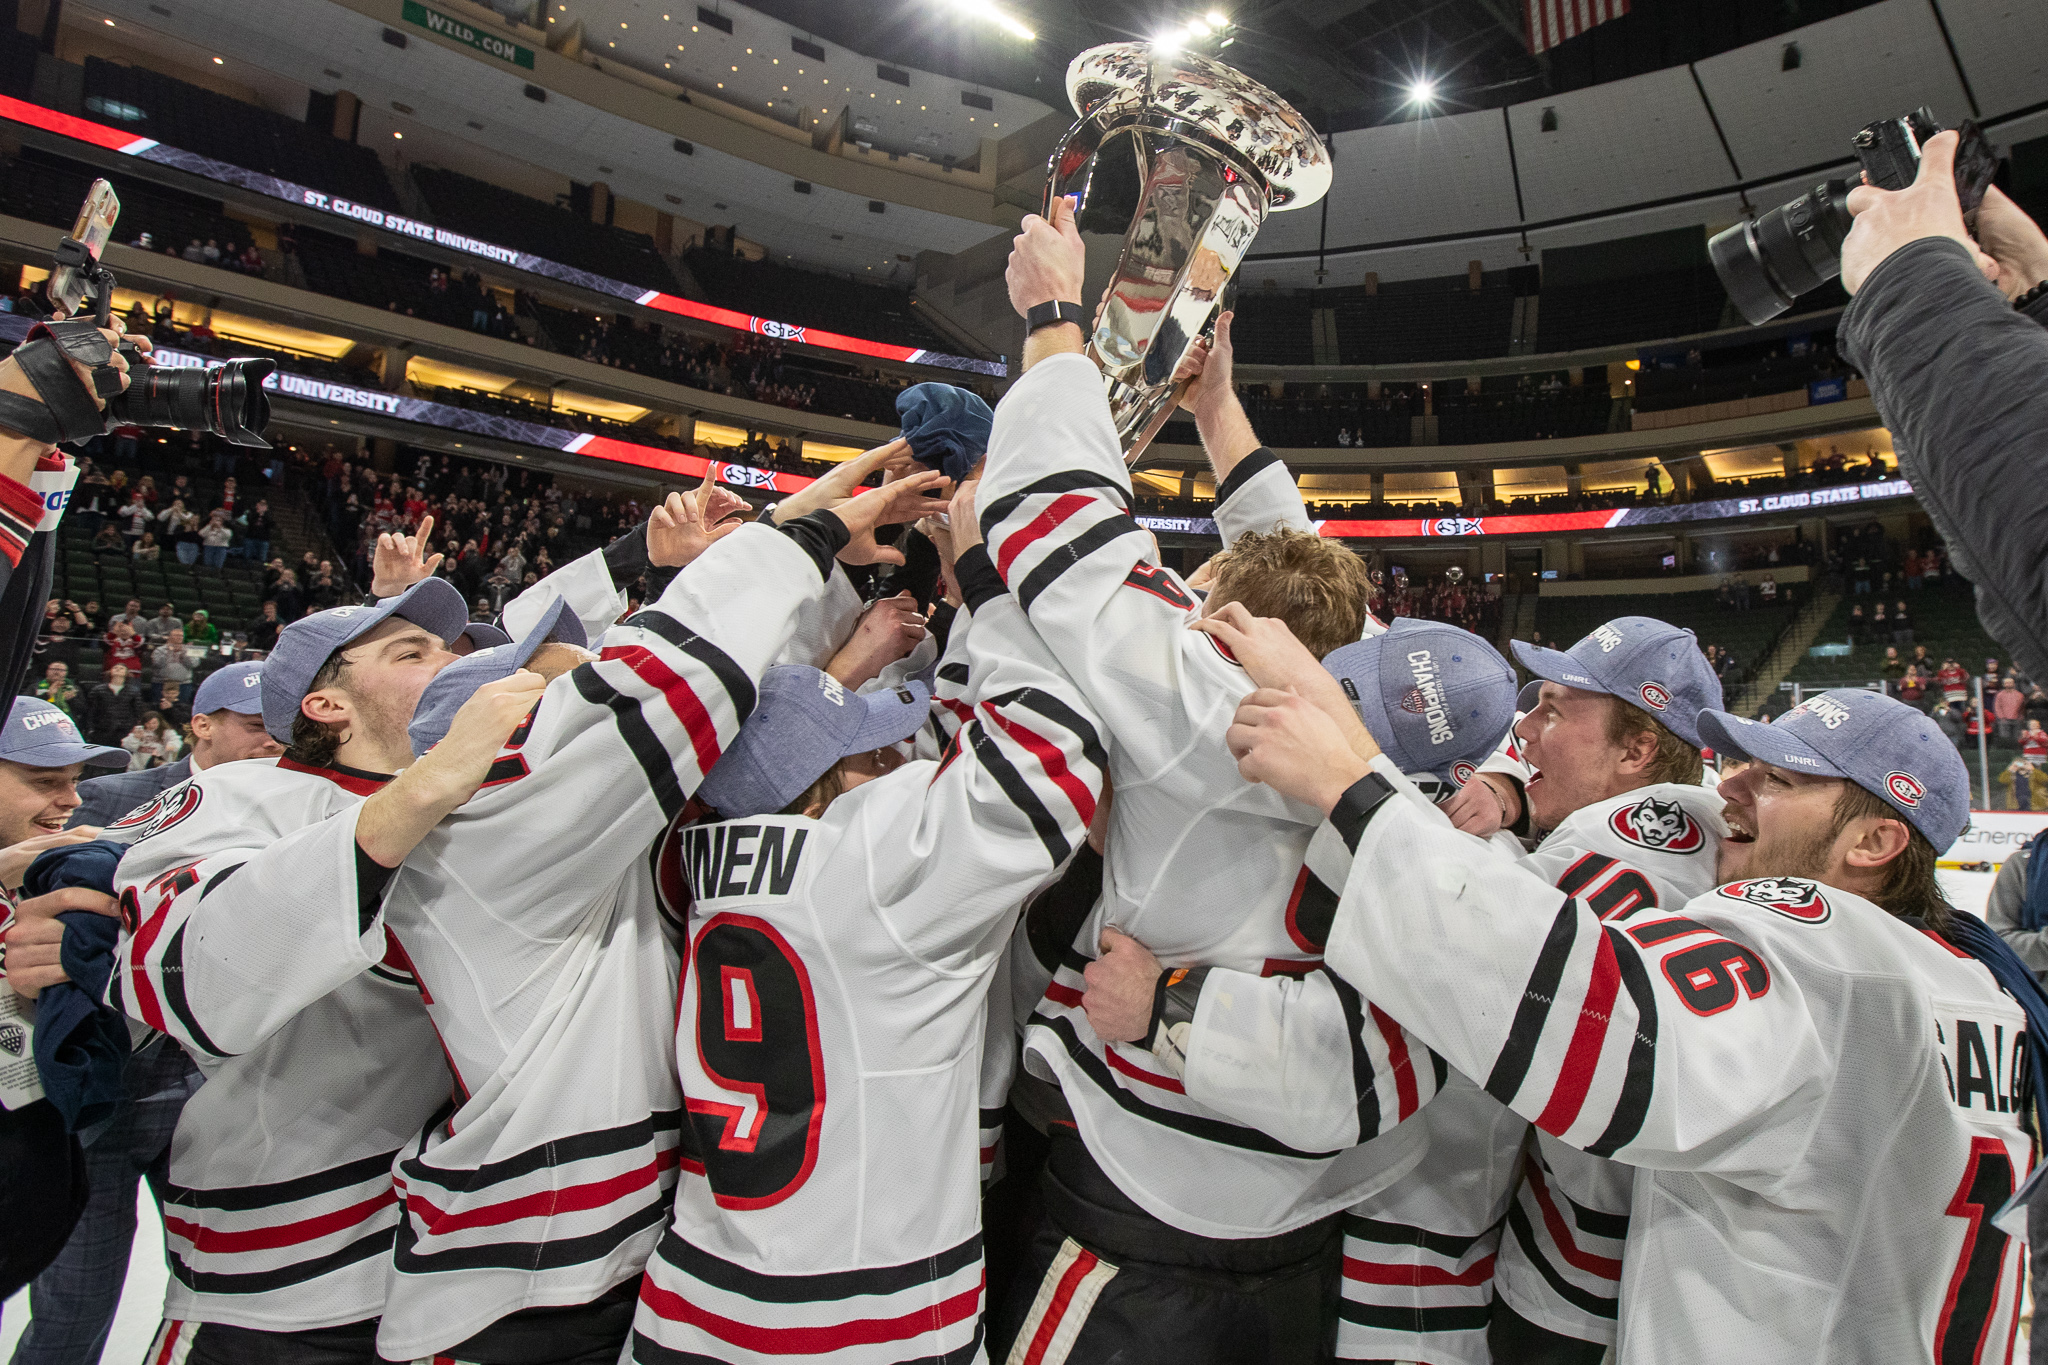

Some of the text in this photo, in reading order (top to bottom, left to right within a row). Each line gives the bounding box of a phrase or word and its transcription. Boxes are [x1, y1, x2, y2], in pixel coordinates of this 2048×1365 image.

[426, 9, 516, 61] WILD.COM
[303, 190, 519, 266] ST. CLOUD STATE UNIVERSITY
[280, 374, 400, 414] UNIVERSITY
[1738, 500, 1764, 514] ST.
[1763, 493, 1811, 512] CLOUD
[1811, 486, 1861, 506] STATE
[1407, 650, 1454, 745] CHAMPIONS
[1562, 673, 1591, 685] UNRL
[1784, 754, 1820, 768] UNRL
[1625, 915, 1771, 1018] 16
